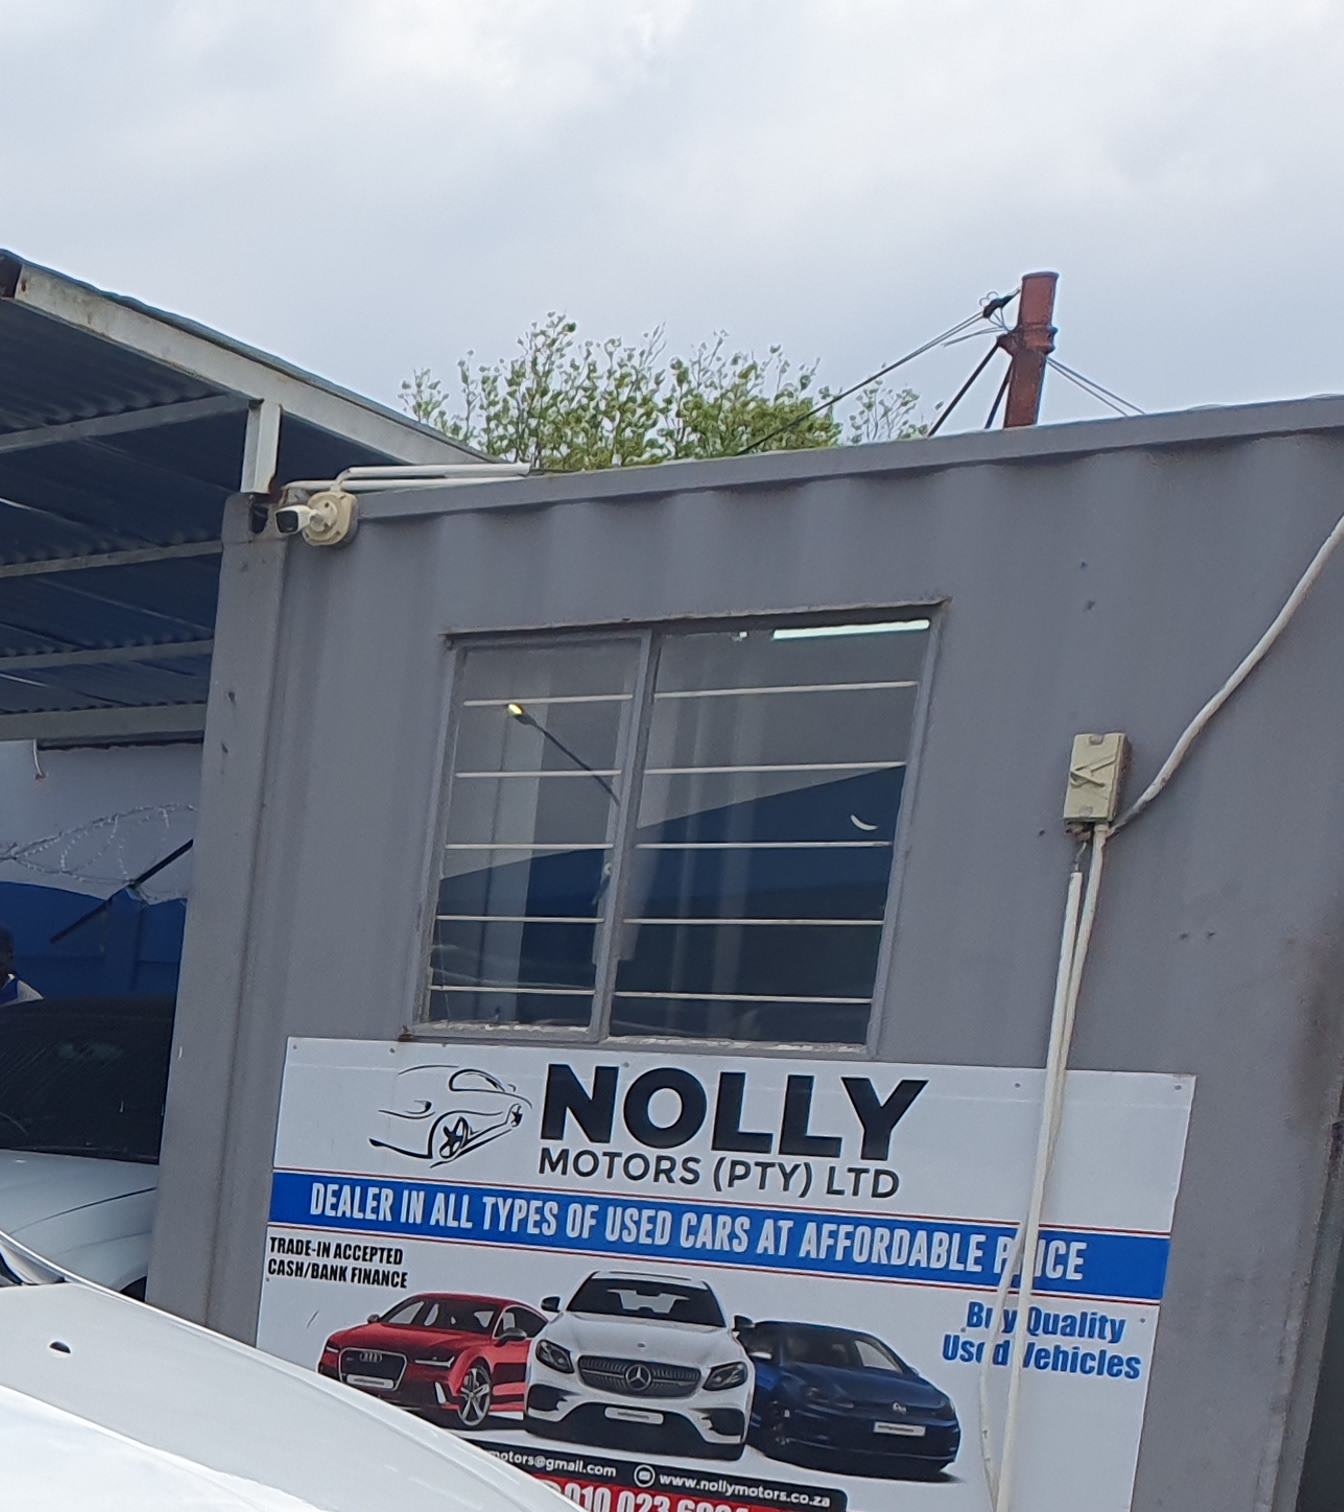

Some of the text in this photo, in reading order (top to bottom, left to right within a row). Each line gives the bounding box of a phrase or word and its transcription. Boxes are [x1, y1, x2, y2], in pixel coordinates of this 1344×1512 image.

[540, 1063, 930, 1161] NOLLY
[538, 1147, 901, 1199] MOTORS (PTY) LTD
[310, 1181, 1088, 1281] DEALER IN ALL TYPES OF USED CARS AT AFFORDABLE PICE
[268, 1236, 404, 1266] TRADE-IN ACCEPTED
[267, 1258, 409, 1289] CASH/BANK FINANCE
[1026, 1306, 1127, 1344] Quality
[659, 1474, 832, 1508] www.nollymotors.co.za
